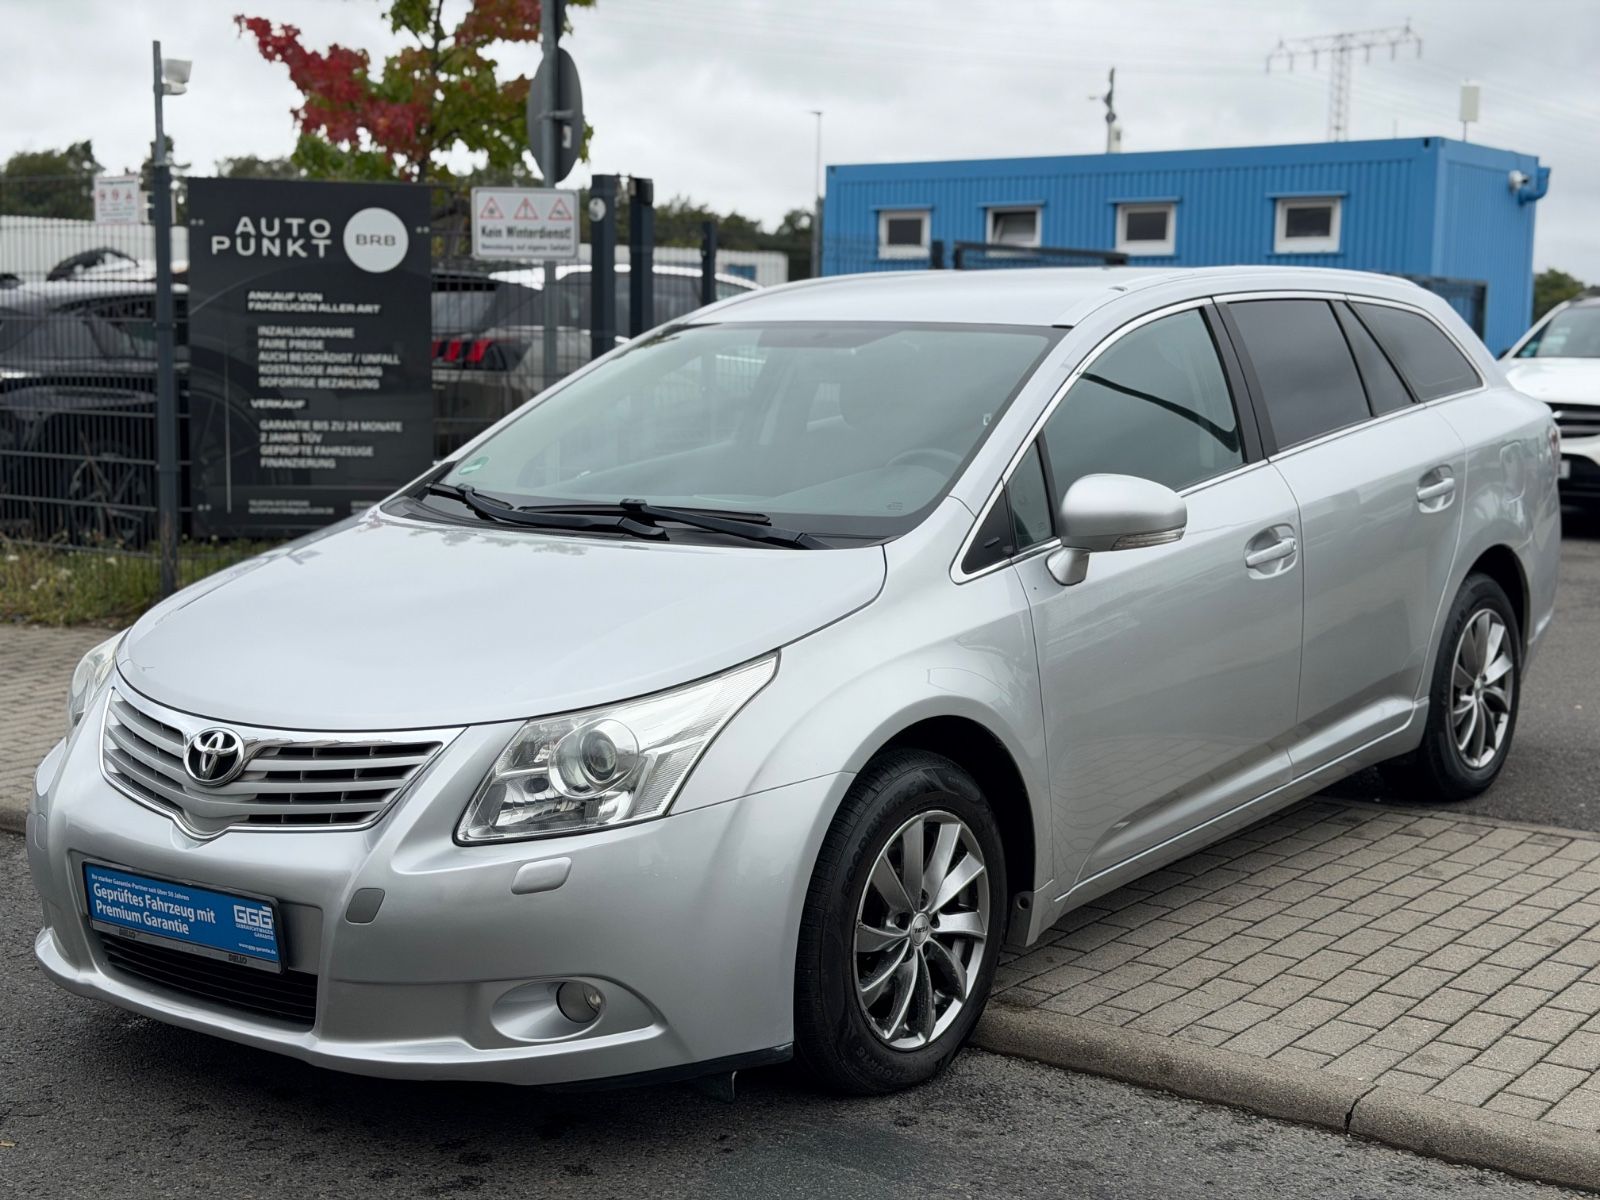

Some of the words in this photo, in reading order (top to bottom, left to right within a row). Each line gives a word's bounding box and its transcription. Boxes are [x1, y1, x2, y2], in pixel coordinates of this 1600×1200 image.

[235, 216, 332, 238] AUTO
[481, 225, 502, 238] Kein
[355, 233, 397, 247] BRB
[211, 236, 332, 258] PUNKT
[248, 291, 296, 301] ANKAUF
[297, 292, 323, 302] VON
[318, 302, 355, 313] ALLER
[356, 303, 381, 314] ART
[257, 338, 287, 349] FAIRE
[288, 339, 324, 350] PREISE
[258, 351, 288, 362] AUCH
[289, 351, 353, 363] BESCHÄDIGT
[361, 353, 400, 365] UNFALL
[258, 364, 324, 375] KOSTENLOSE
[325, 365, 383, 377] ABHOLUNG
[258, 376, 316, 388] SOFORTIGE
[317, 378, 380, 389] BEZAHLUNG
[250, 398, 306, 409] VERKAUF
[259, 419, 311, 431] GARANTIE
[312, 421, 329, 431] BIS
[330, 421, 345, 432] ZU
[346, 421, 359, 432] 24
[360, 421, 403, 432] MONATE
[268, 432, 300, 443] JAHRE
[301, 430, 323, 443] TÜV
[259, 443, 313, 456] GEPRÜFTE
[314, 446, 374, 457] FAHRZEUGE
[260, 457, 336, 469] FINANZIERUNG
[93, 882, 144, 908] Geprüftes
[145, 894, 195, 922] Fahrzeug
[197, 907, 216, 924] mit
[95, 900, 142, 923] Premium
[143, 911, 190, 935] Garantie
[233, 904, 275, 930] GGG
